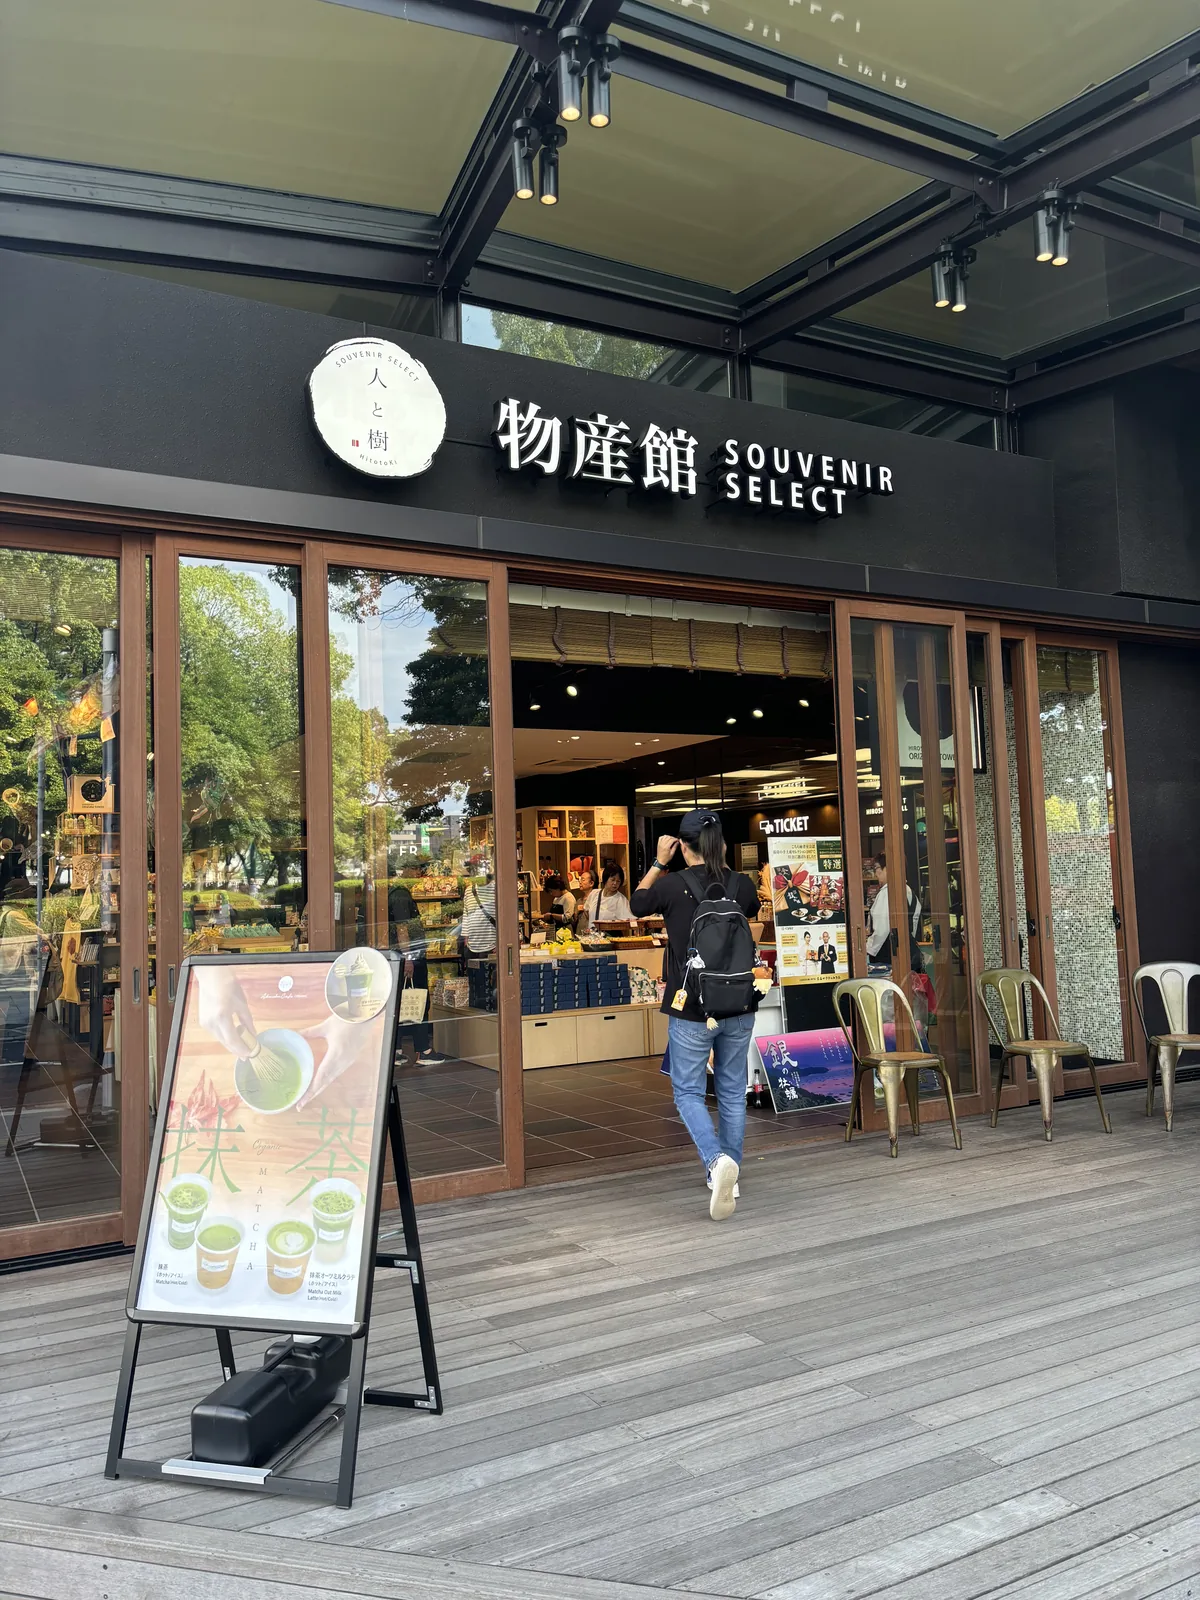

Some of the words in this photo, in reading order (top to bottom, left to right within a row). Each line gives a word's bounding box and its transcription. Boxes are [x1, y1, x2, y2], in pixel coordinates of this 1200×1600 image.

[335, 350, 383, 368] SOUVENIR
[387, 355, 420, 382] SELECT
[367, 367, 389, 452] 人と樹
[497, 398, 699, 496] 物産館
[725, 438, 894, 493] SOUVENIR
[726, 472, 847, 515] SELECT
[773, 815, 810, 834] TICKET
[252, 1139, 283, 1155] Organic
